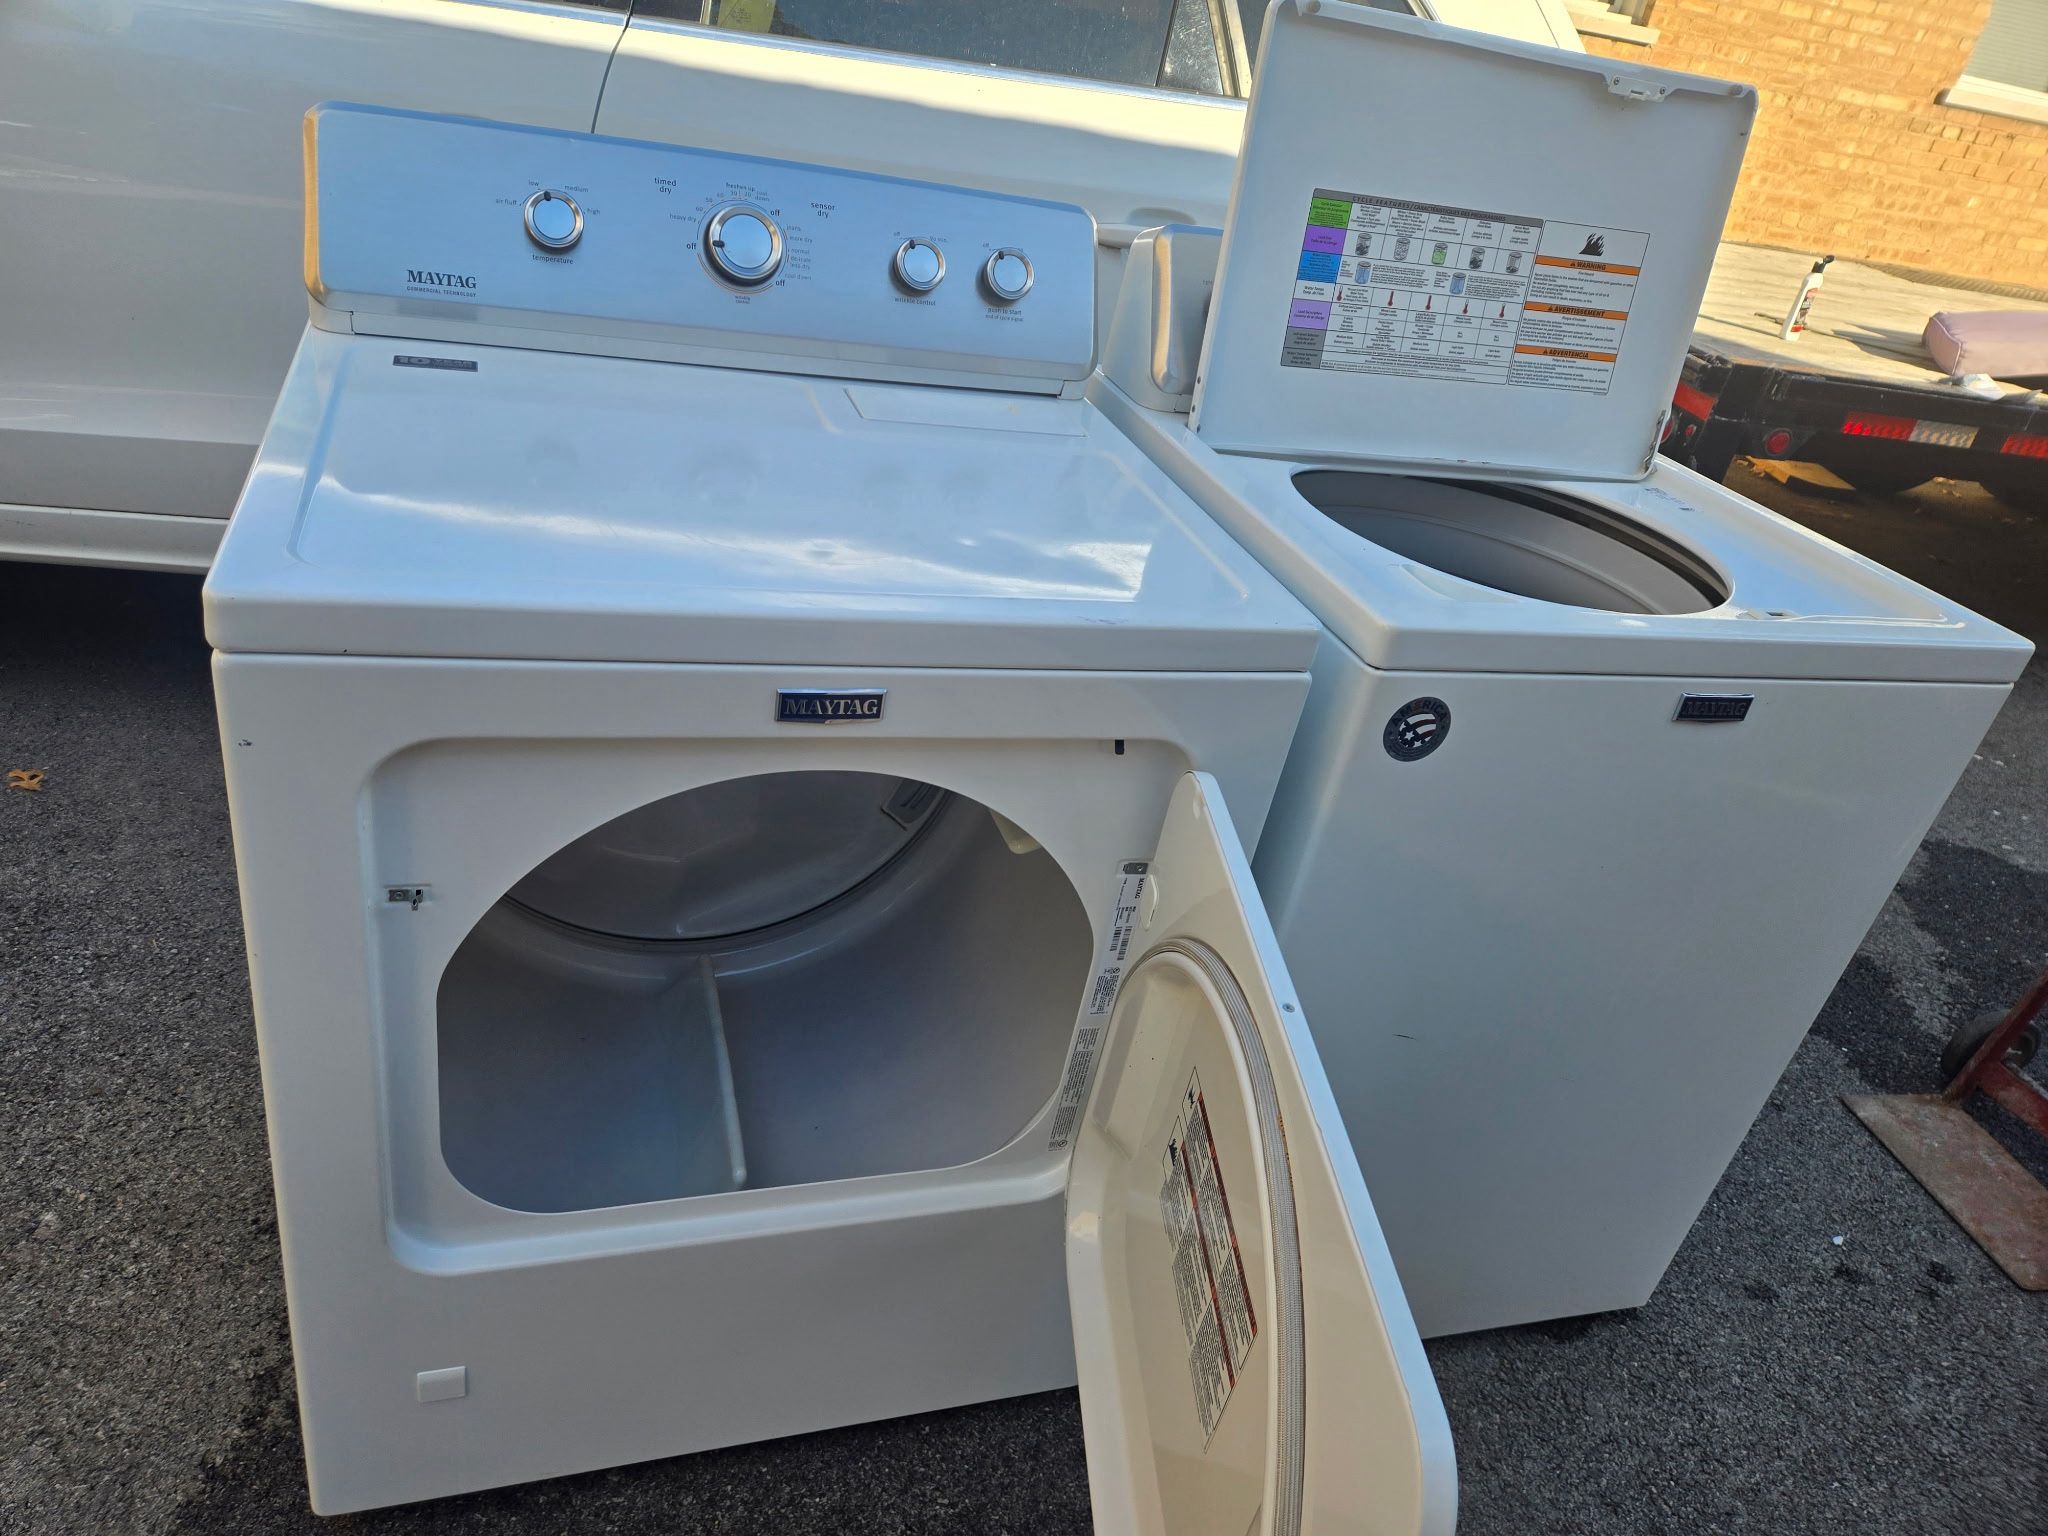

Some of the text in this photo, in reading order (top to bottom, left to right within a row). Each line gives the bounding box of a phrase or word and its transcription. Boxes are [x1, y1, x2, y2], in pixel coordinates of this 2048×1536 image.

[654, 177, 677, 187] timed
[564, 185, 589, 193] medium
[659, 186, 672, 195] dry
[504, 198, 517, 206] fluff
[811, 202, 836, 211] sensor
[1352, 196, 1373, 205] CYCLE
[1375, 199, 1410, 209] FEATURES
[669, 213, 697, 224] heavy dry
[817, 210, 829, 219] dry
[686, 242, 697, 250] off
[532, 254, 574, 265] temperature
[1577, 261, 1607, 271] WARNING
[406, 269, 477, 289] MAYTAG
[406, 286, 477, 298] COMMERCIAL TECHNOLOGY
[1554, 305, 1605, 317] AVERTISSEMENT
[1548, 349, 1589, 359] ADVERTENCIA
[783, 699, 879, 715] MAYTAG
[1134, 877, 1145, 899] MAYTAG
